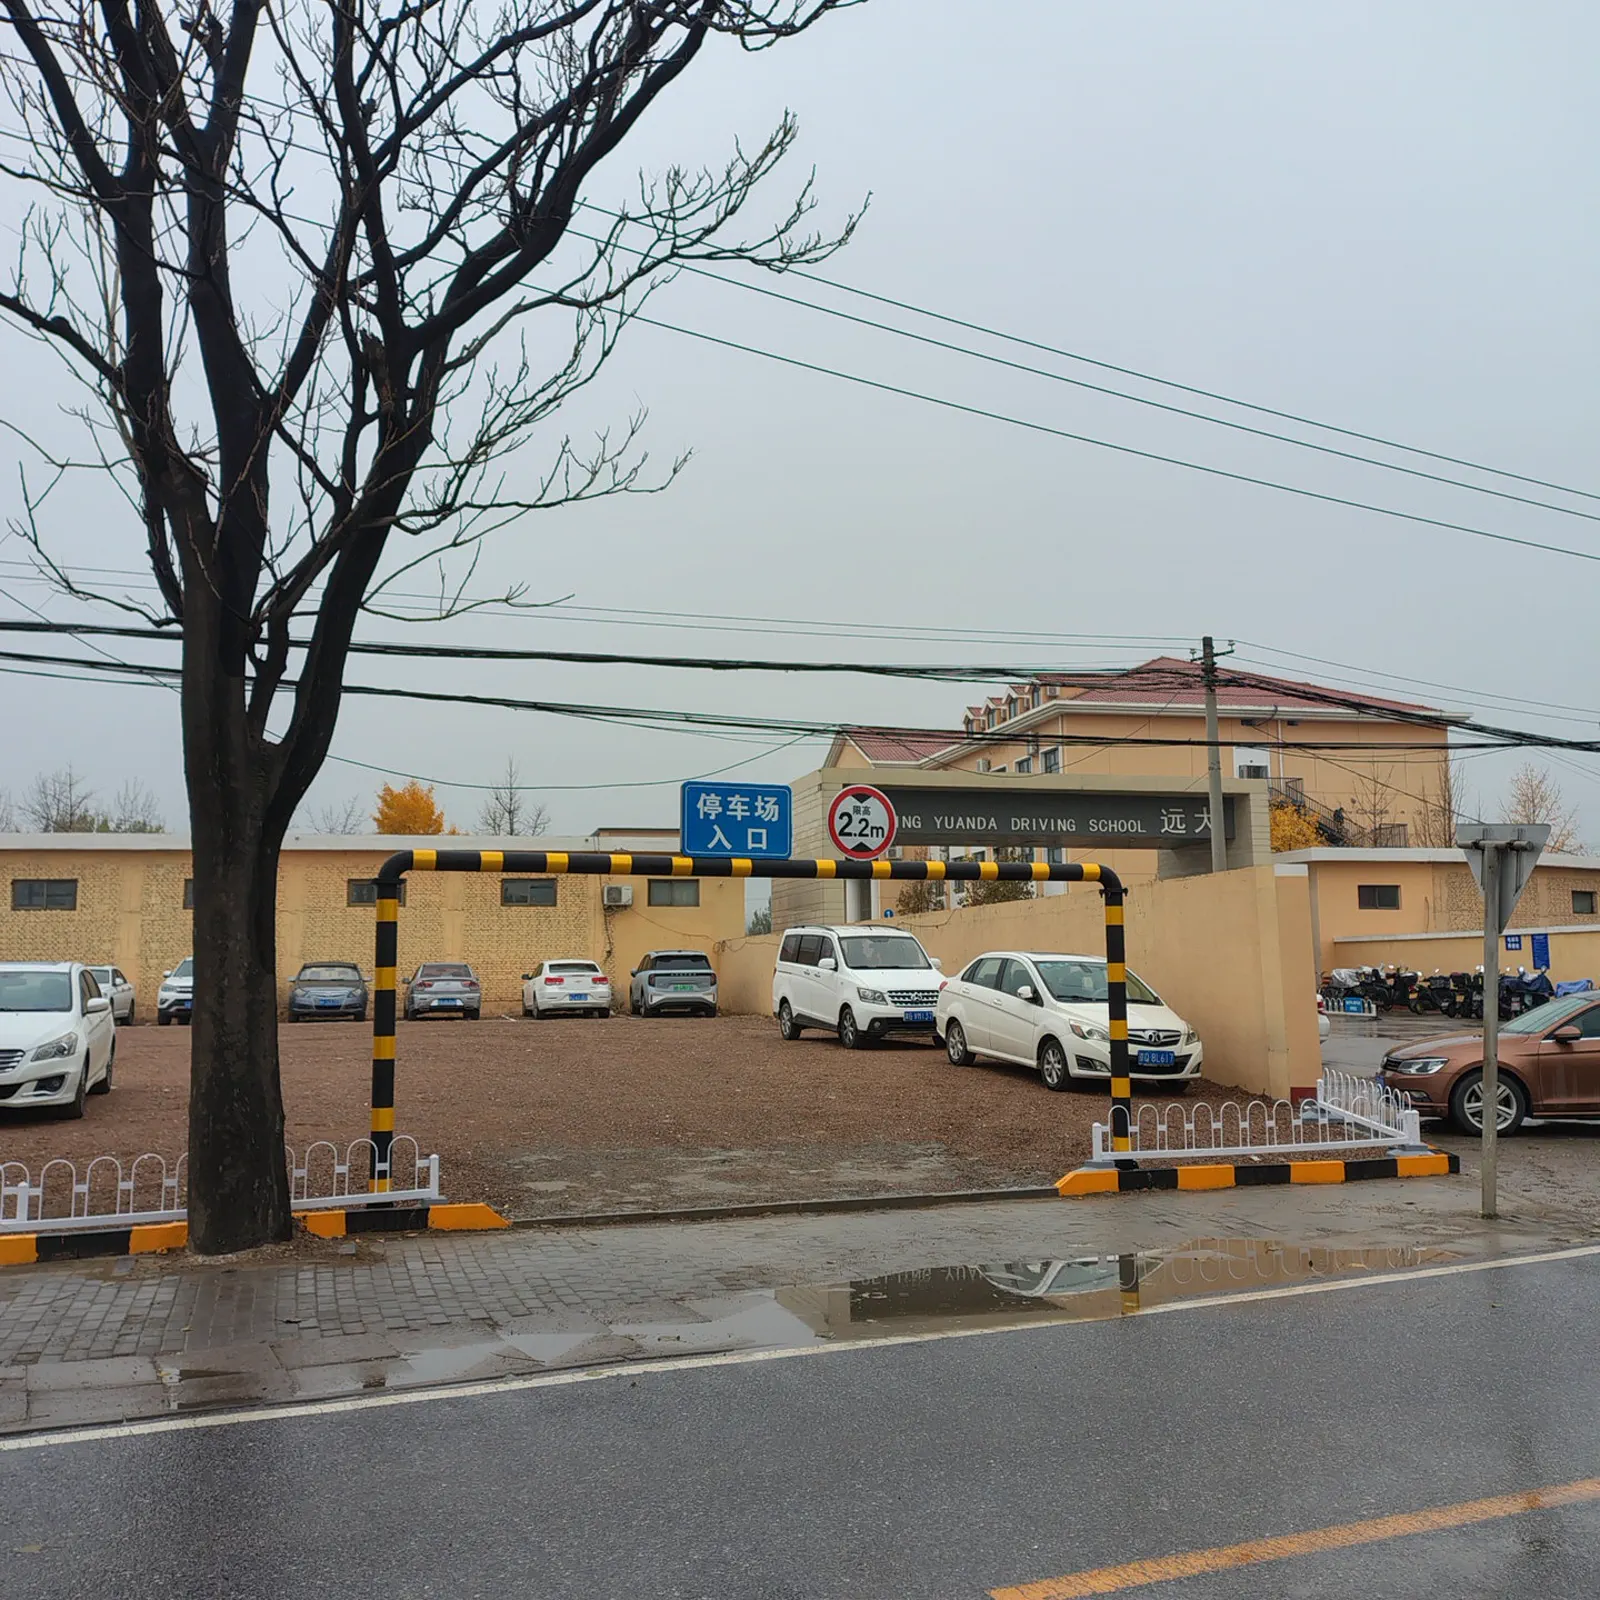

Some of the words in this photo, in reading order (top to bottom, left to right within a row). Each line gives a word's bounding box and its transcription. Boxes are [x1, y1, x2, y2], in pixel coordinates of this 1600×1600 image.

[696, 793, 779, 822] 停车场
[852, 805, 871, 816] 限高
[1160, 806, 1211, 833] 远大
[707, 824, 767, 850] 入口
[838, 811, 885, 838] 2.2m
[933, 815, 997, 830] YUANDA
[1011, 817, 1076, 831] DRIVING
[1089, 818, 1147, 833] SCHOOL
